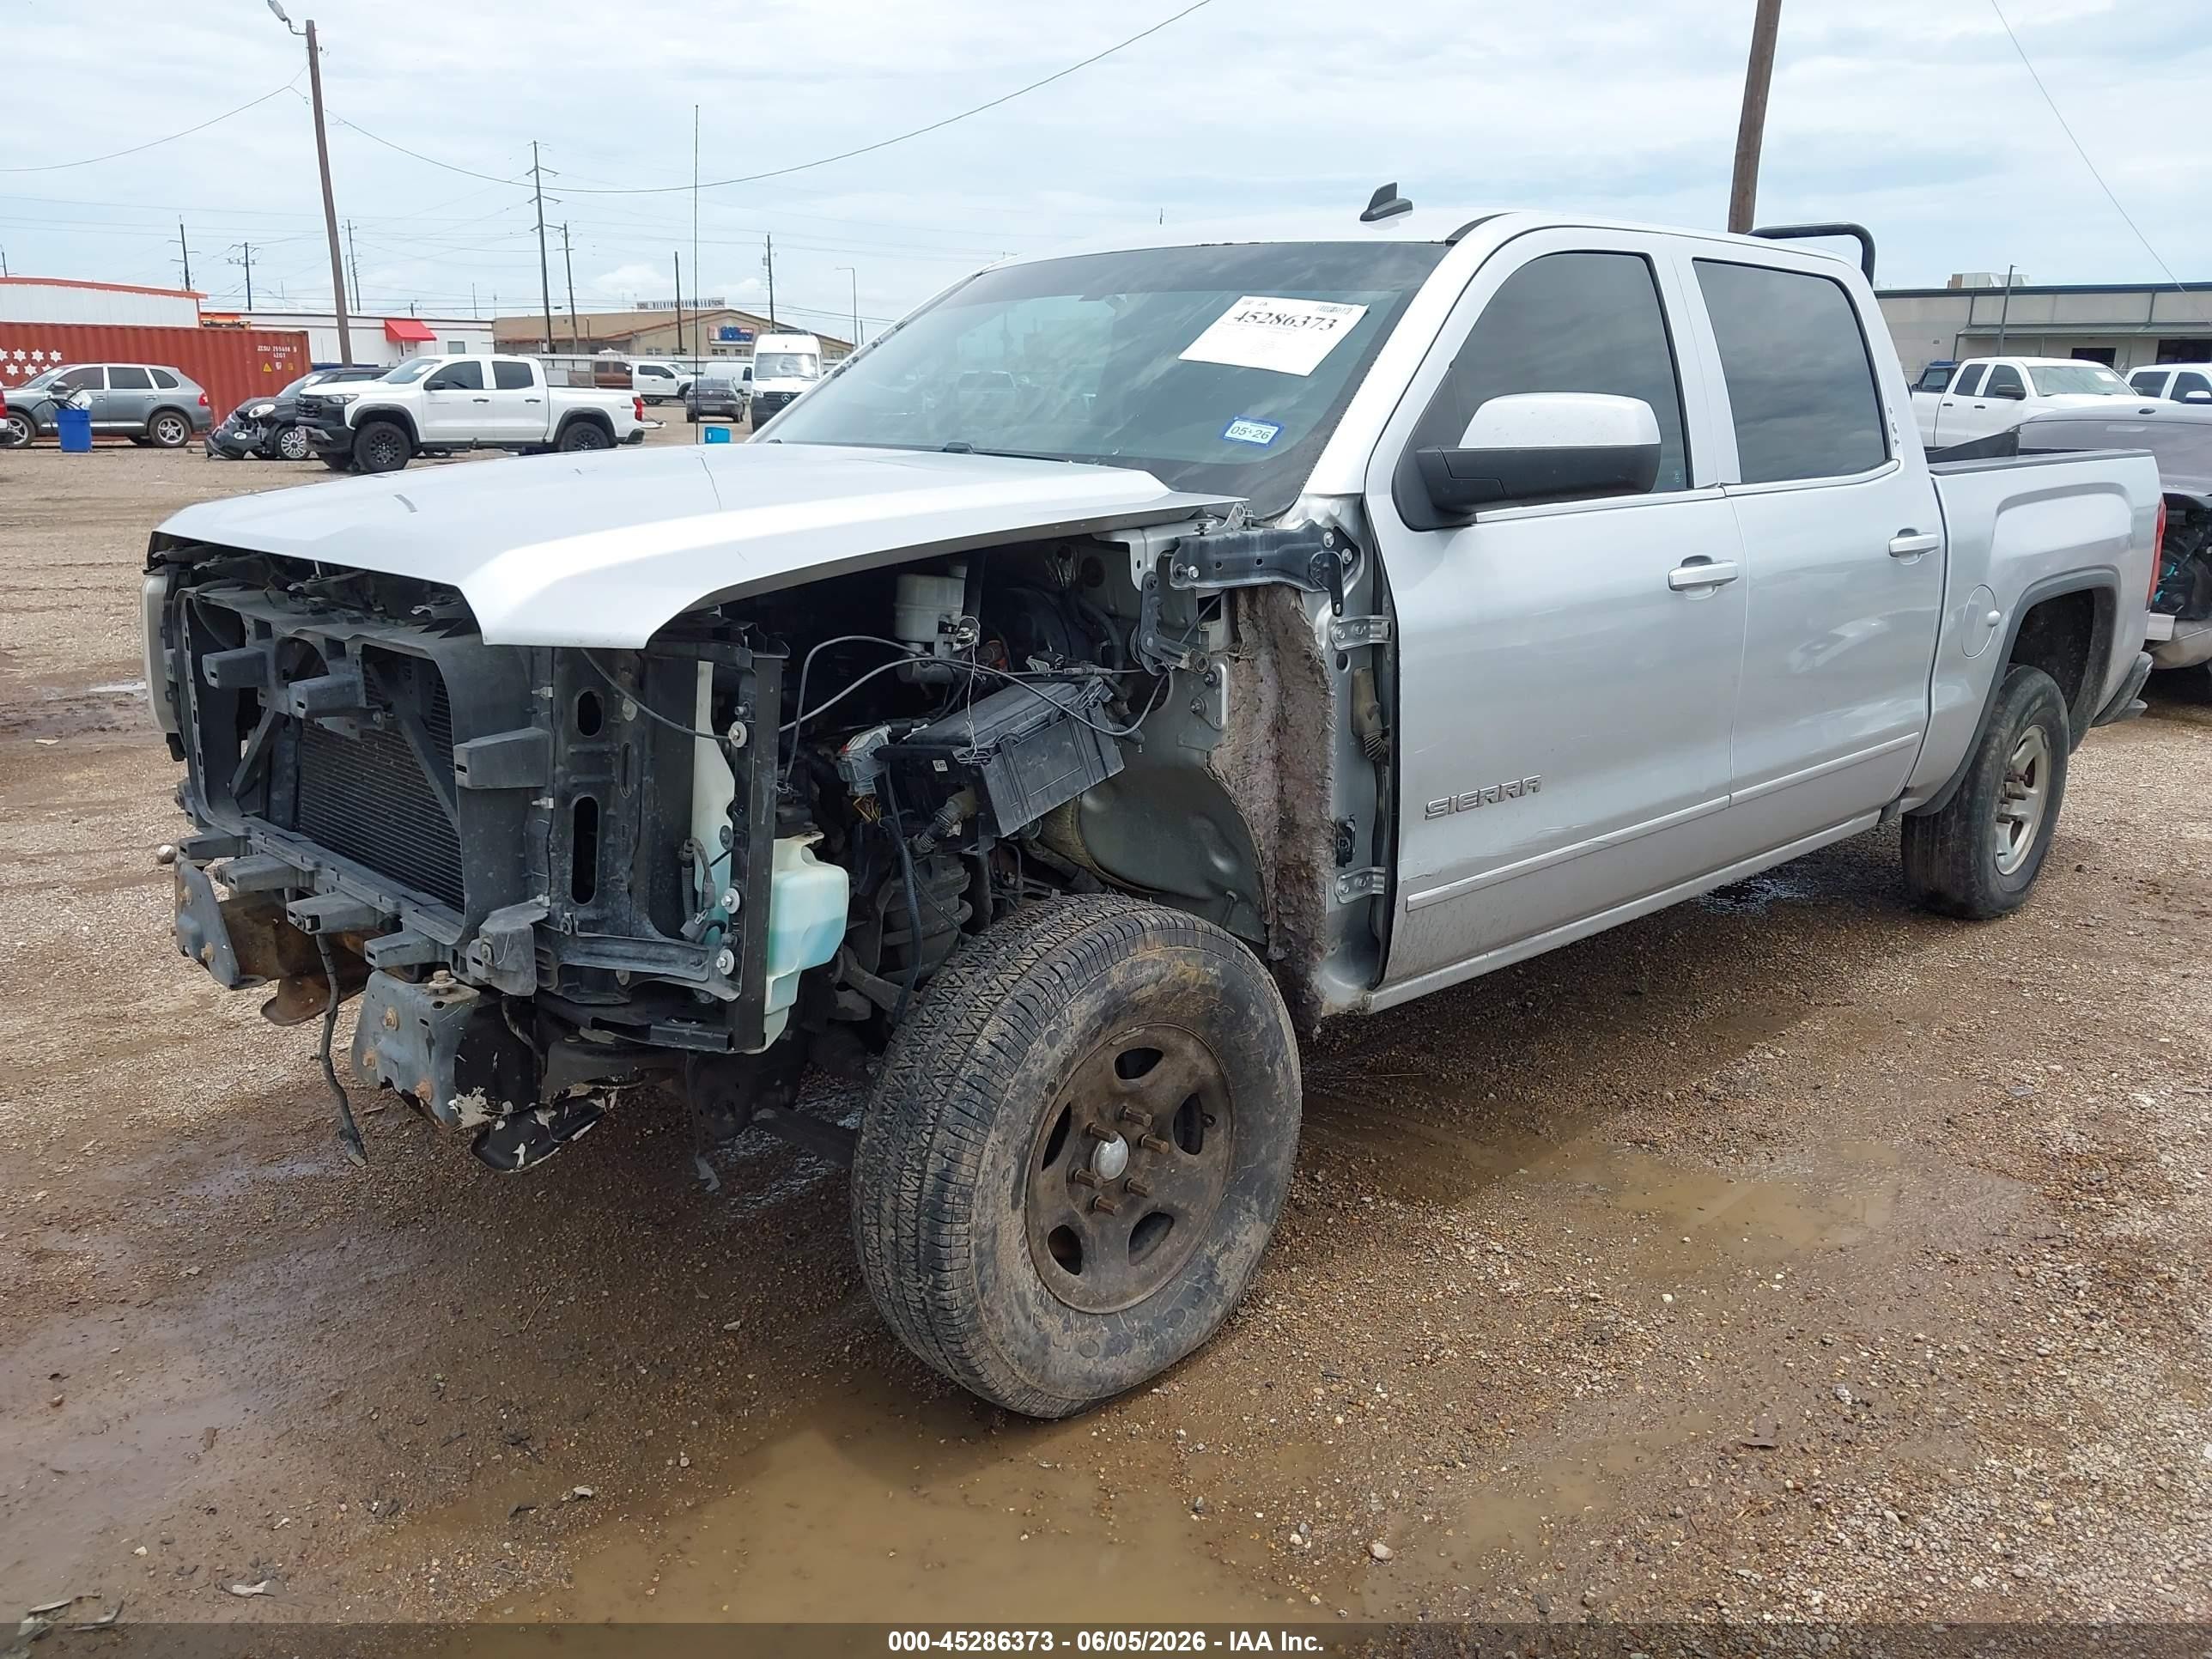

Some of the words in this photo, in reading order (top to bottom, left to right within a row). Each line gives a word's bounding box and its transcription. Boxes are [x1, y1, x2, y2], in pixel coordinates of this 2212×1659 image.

[1233, 310, 1338, 331] 45286373
[1231, 426, 1249, 436] 05
[1251, 429, 1272, 440] 26
[1425, 774, 1543, 820] SIERRA
